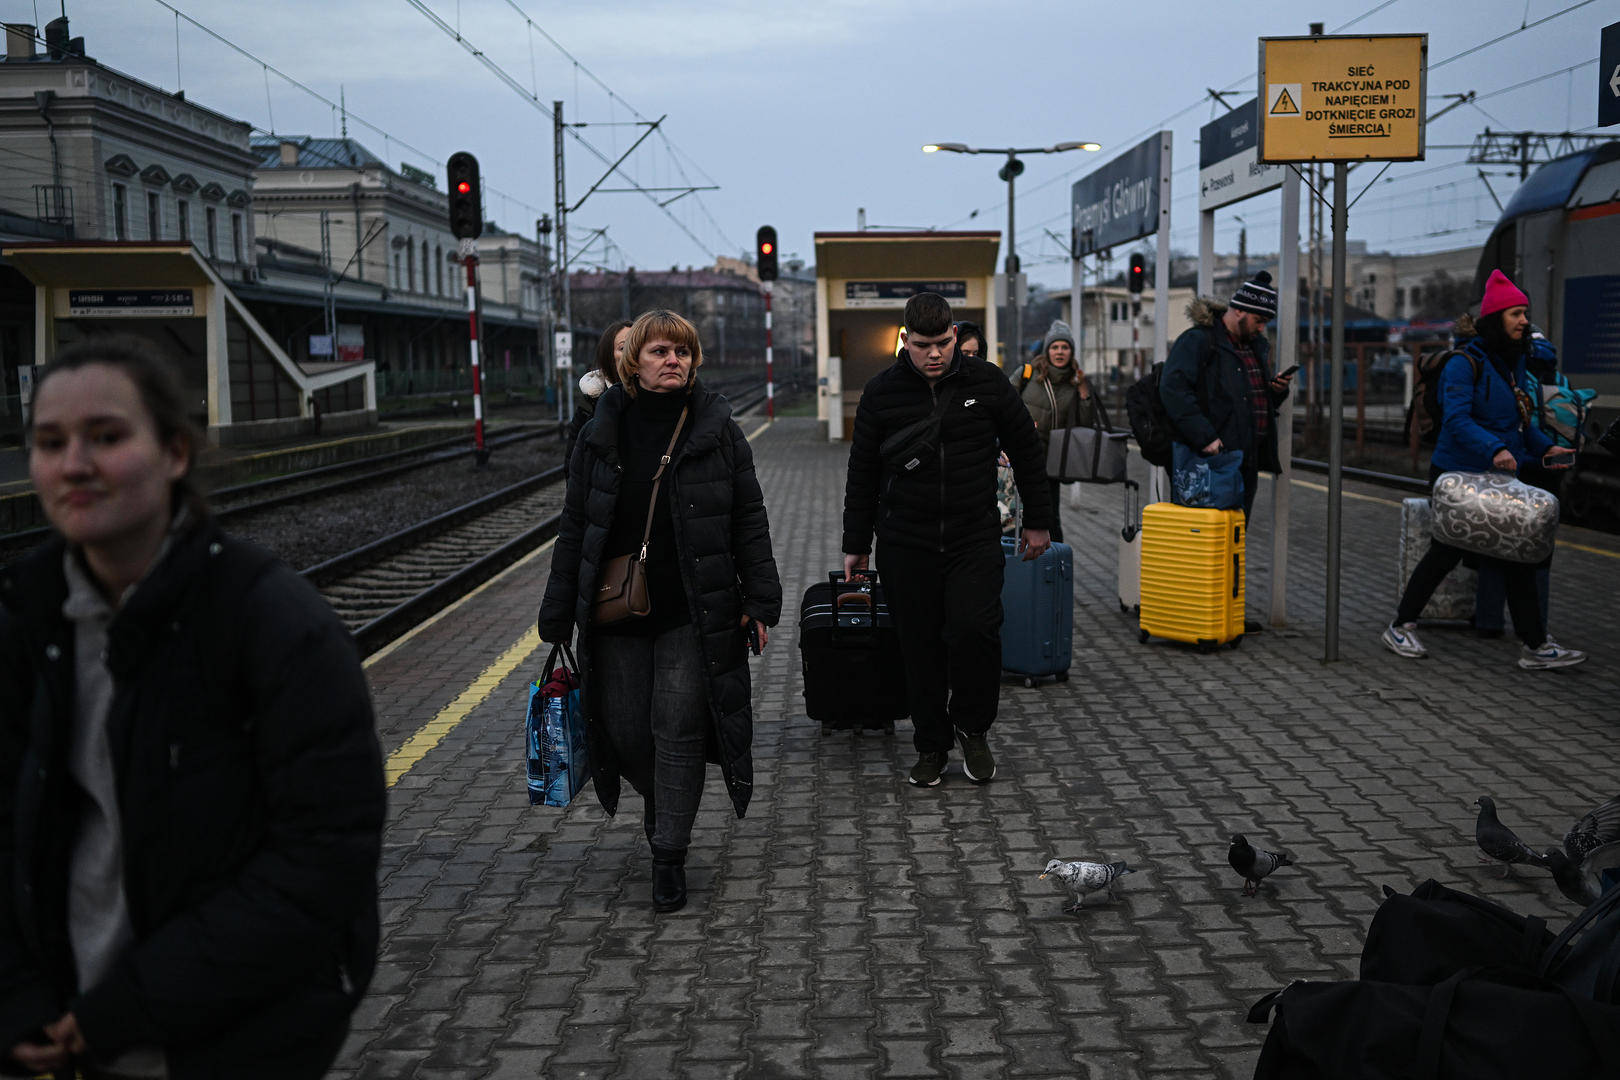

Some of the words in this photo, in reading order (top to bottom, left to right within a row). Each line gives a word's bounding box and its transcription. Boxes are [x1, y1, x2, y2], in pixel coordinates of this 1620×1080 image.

[1347, 64, 1375, 77] SIEĆ
[1312, 80, 1382, 92] TRAKCYJNA
[1386, 79, 1410, 90] POD
[1325, 95, 1389, 107] NAPIĘCIEM
[1392, 94, 1396, 105] !
[1305, 109, 1376, 122] DOTKNIĘCIE
[1379, 108, 1416, 119] GROZI
[1328, 122, 1385, 136] ŚMIERCIĄ
[1387, 123, 1392, 133] !
[1112, 176, 1153, 219] Główny
